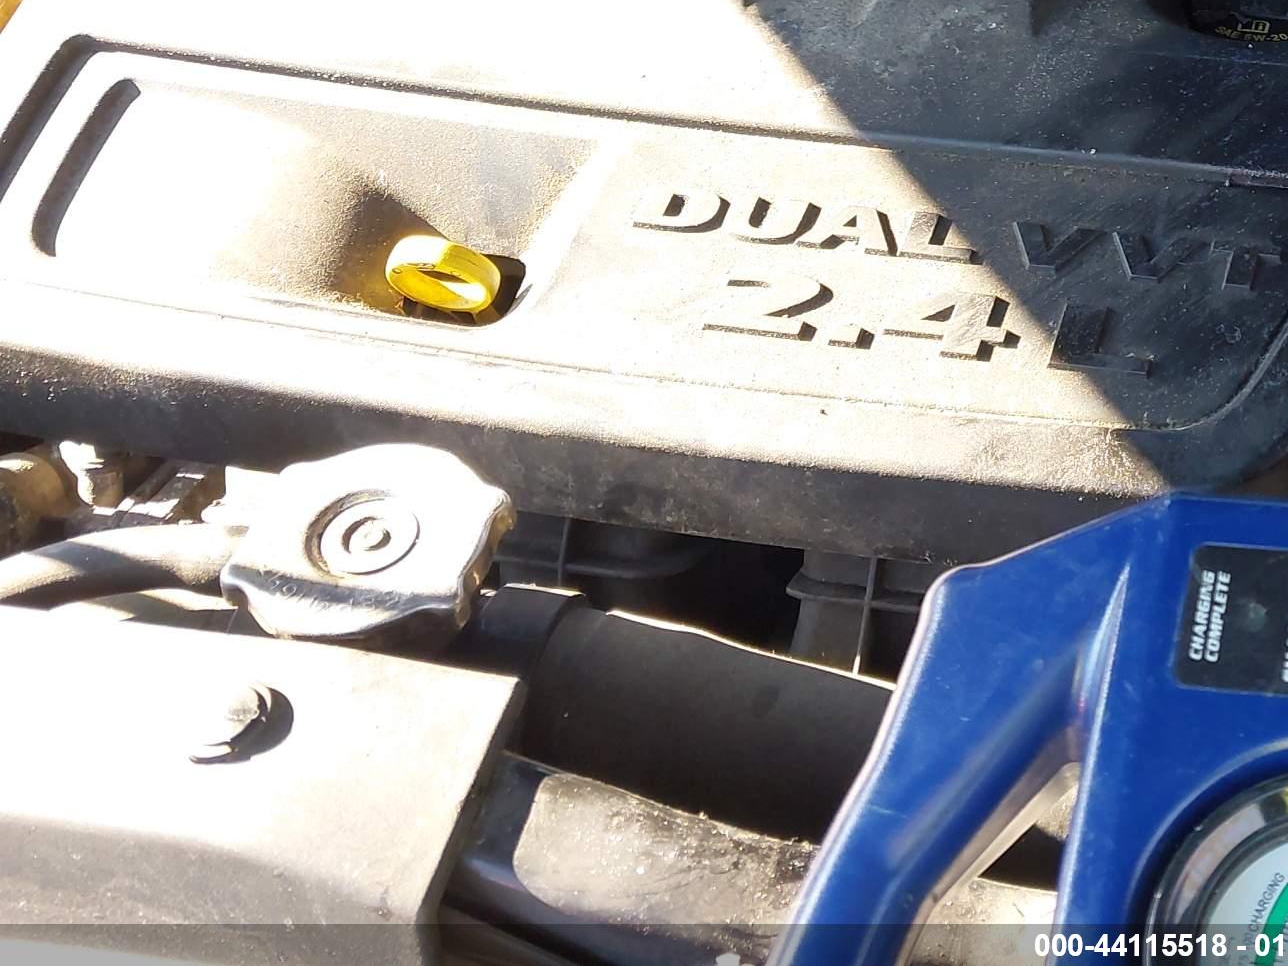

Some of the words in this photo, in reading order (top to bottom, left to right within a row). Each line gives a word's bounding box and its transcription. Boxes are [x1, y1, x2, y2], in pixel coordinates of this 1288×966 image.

[632, 189, 984, 265] DUAL
[1012, 219, 1283, 291] VVT
[702, 274, 1155, 379] 2.4L
[1188, 570, 1216, 661] CHARGING
[1204, 571, 1232, 663] COMPLETE
[1250, 871, 1286, 933] CHARGING
